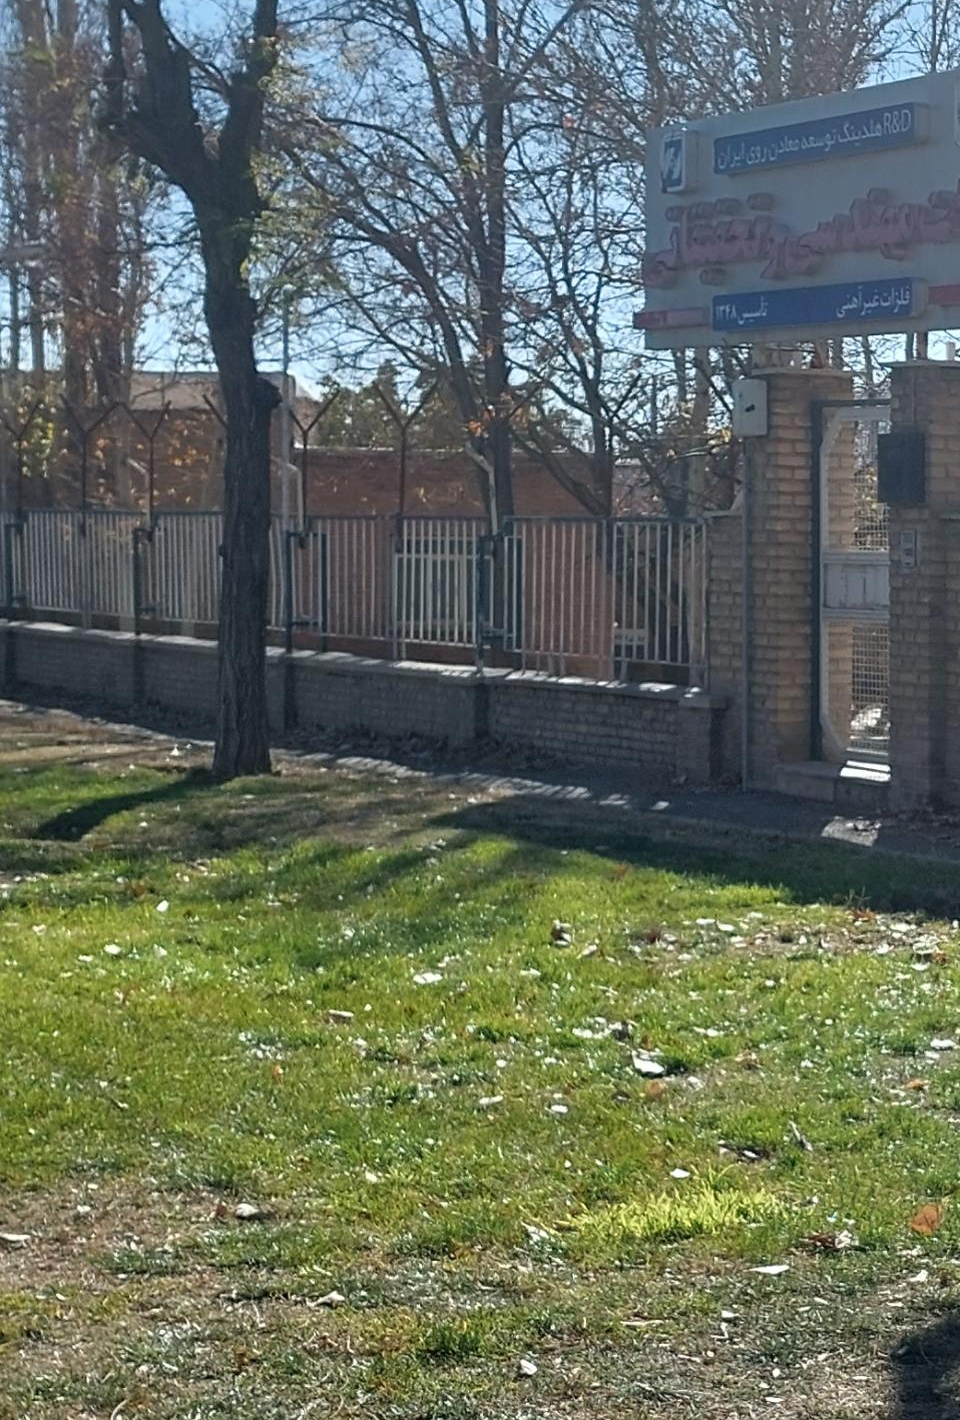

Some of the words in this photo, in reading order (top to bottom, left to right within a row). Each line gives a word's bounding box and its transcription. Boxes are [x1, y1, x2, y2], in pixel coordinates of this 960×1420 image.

[838, 119, 883, 146] هلدینگ
[882, 109, 912, 136] R&D
[769, 134, 800, 161] معادن
[801, 130, 837, 152] توسعه
[718, 141, 746, 170] ایران
[747, 148, 767, 165] روی
[715, 303, 737, 322] ۱۳۴۸
[880, 285, 911, 313] فلزات
